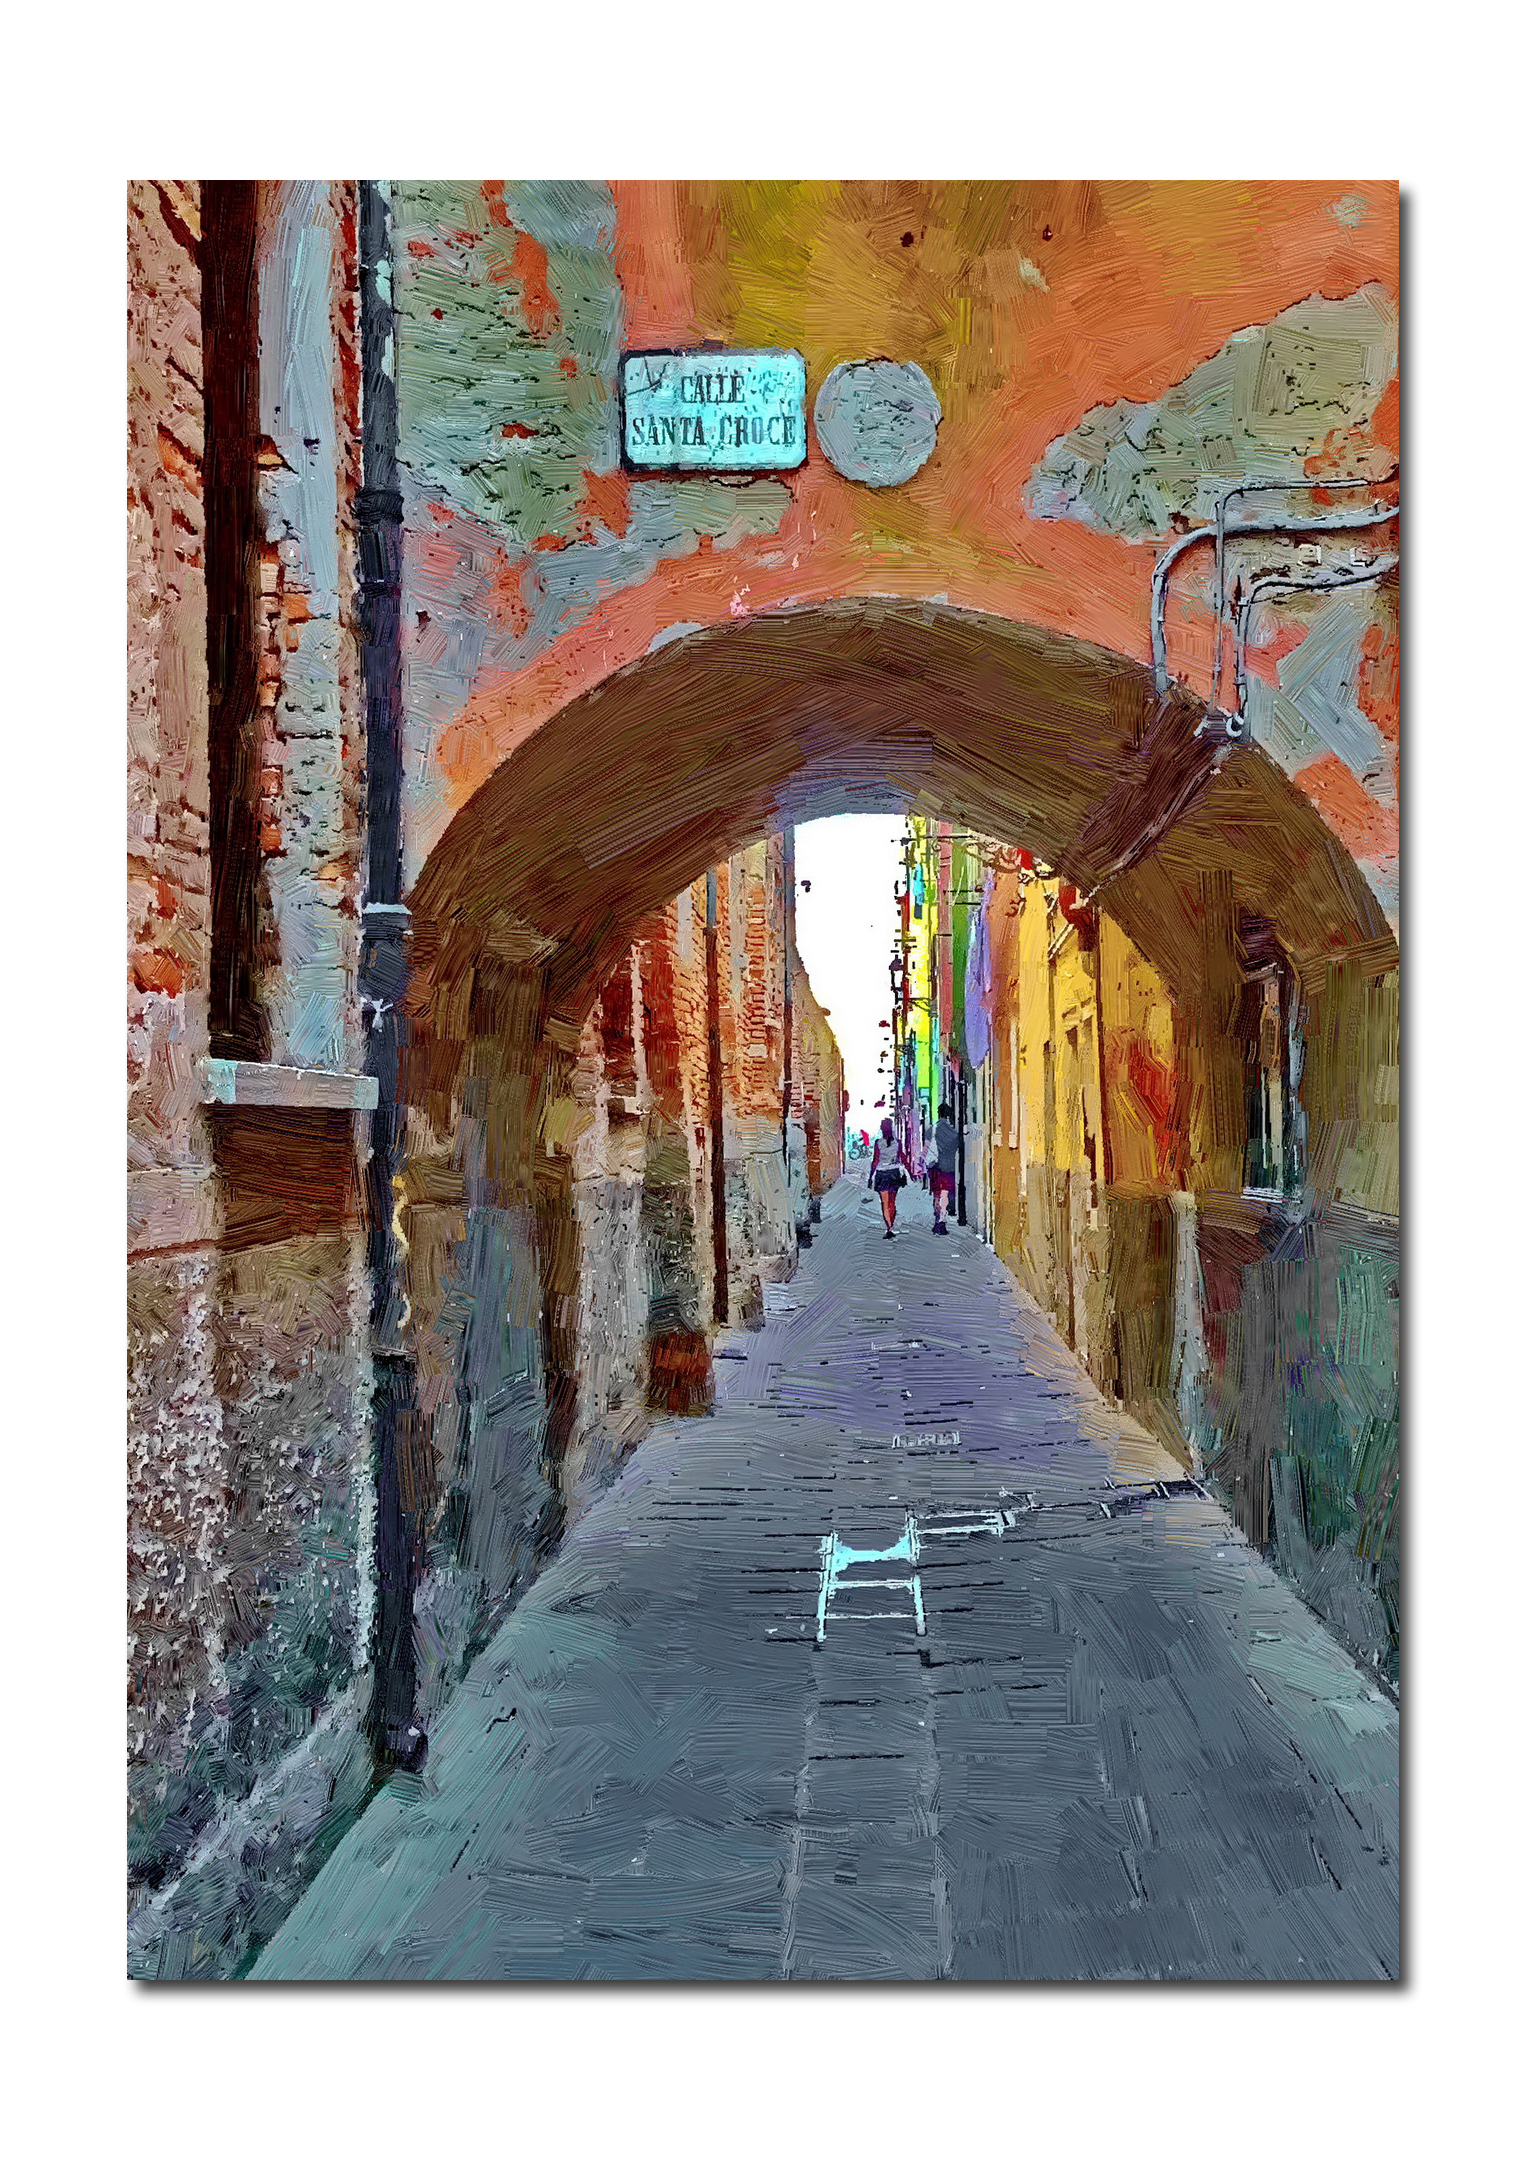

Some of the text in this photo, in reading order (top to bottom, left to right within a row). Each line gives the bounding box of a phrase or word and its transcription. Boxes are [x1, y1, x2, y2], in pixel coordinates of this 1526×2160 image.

[680, 373, 745, 404] CALLE
[632, 415, 796, 446] SANTA CROCE
